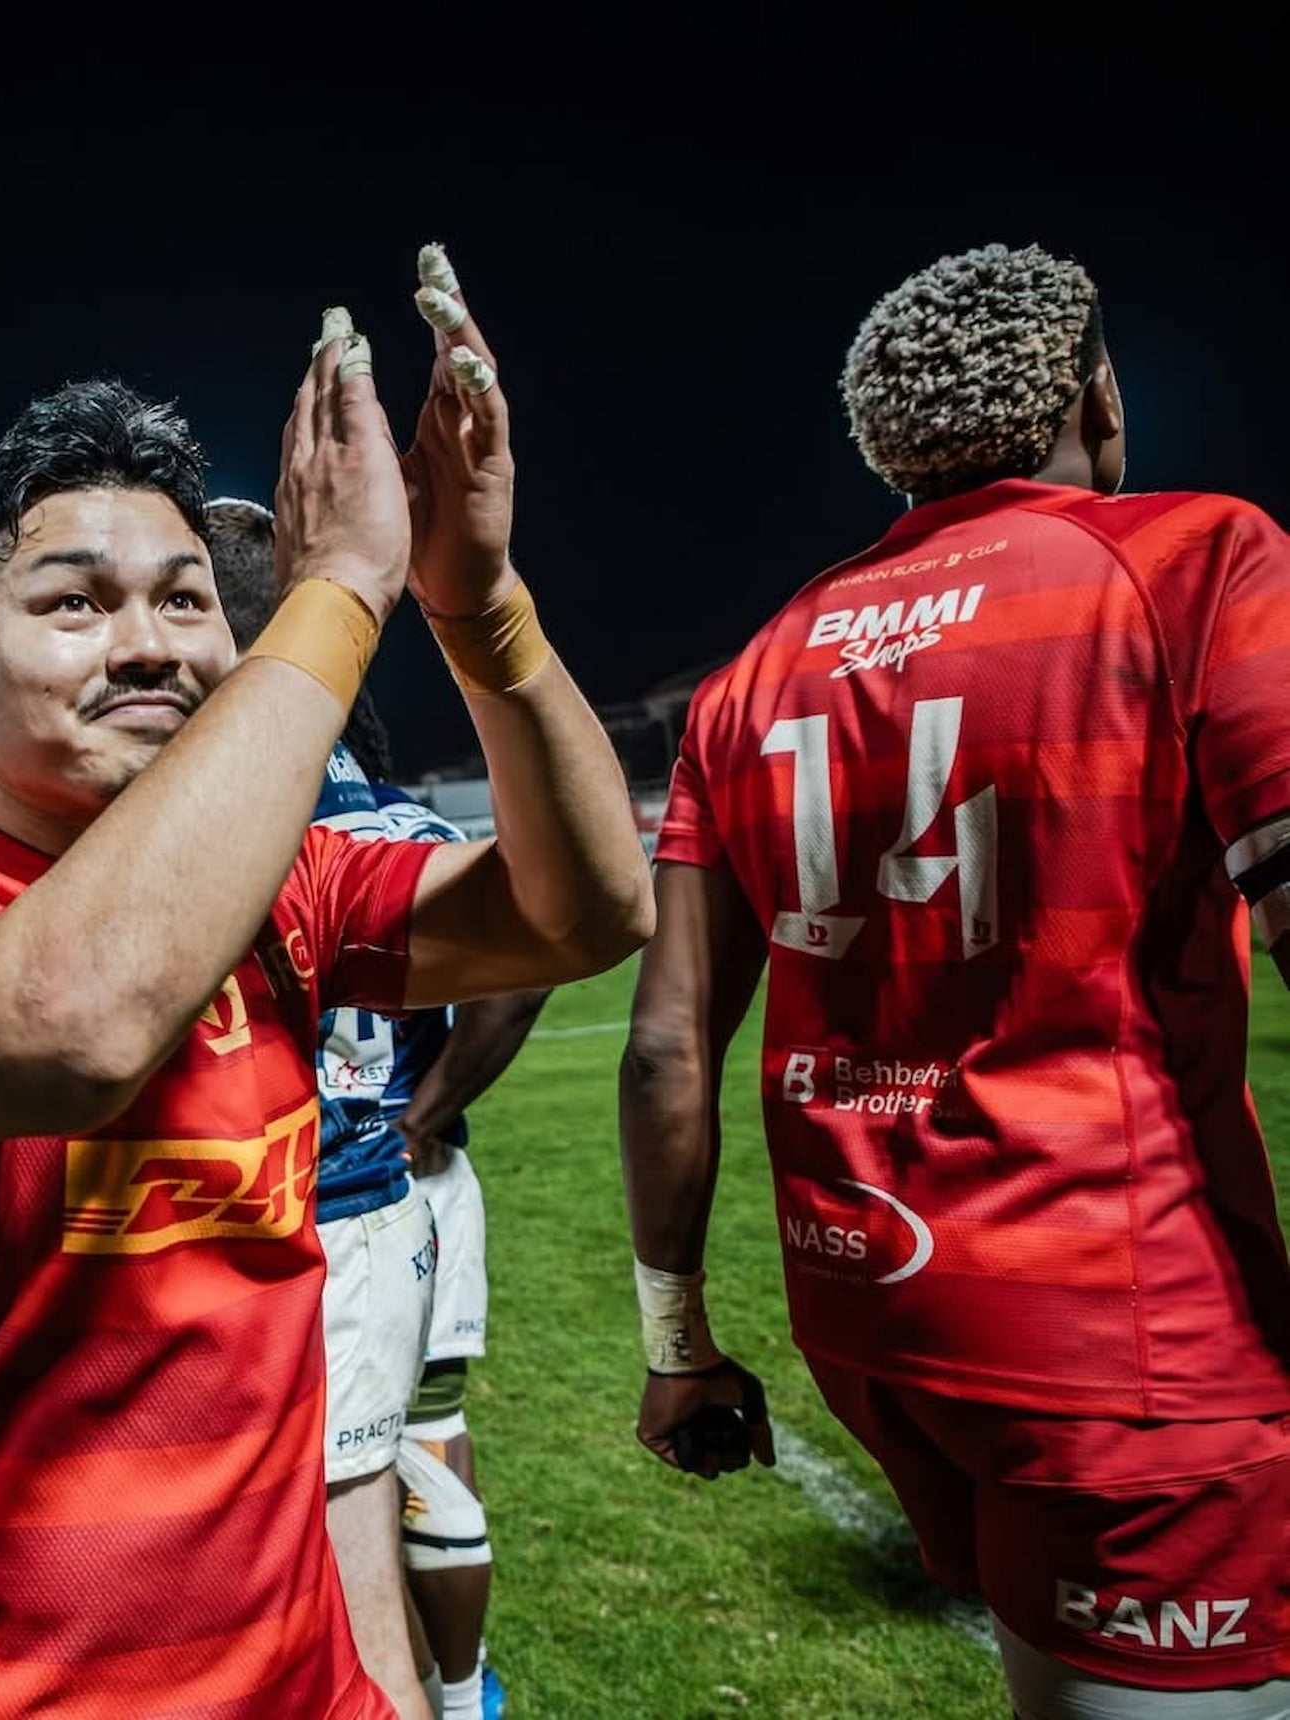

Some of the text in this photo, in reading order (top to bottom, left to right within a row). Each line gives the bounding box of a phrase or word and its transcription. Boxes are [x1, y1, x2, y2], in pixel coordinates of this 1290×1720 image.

[891, 558, 942, 579] RUGBY
[967, 539, 1009, 561] CLUB
[806, 584, 985, 648] BMMI
[829, 624, 943, 679] Shops
[760, 695, 1000, 960] 14
[786, 1215, 868, 1260] NASS
[1055, 1578, 1250, 1649] BANZ
